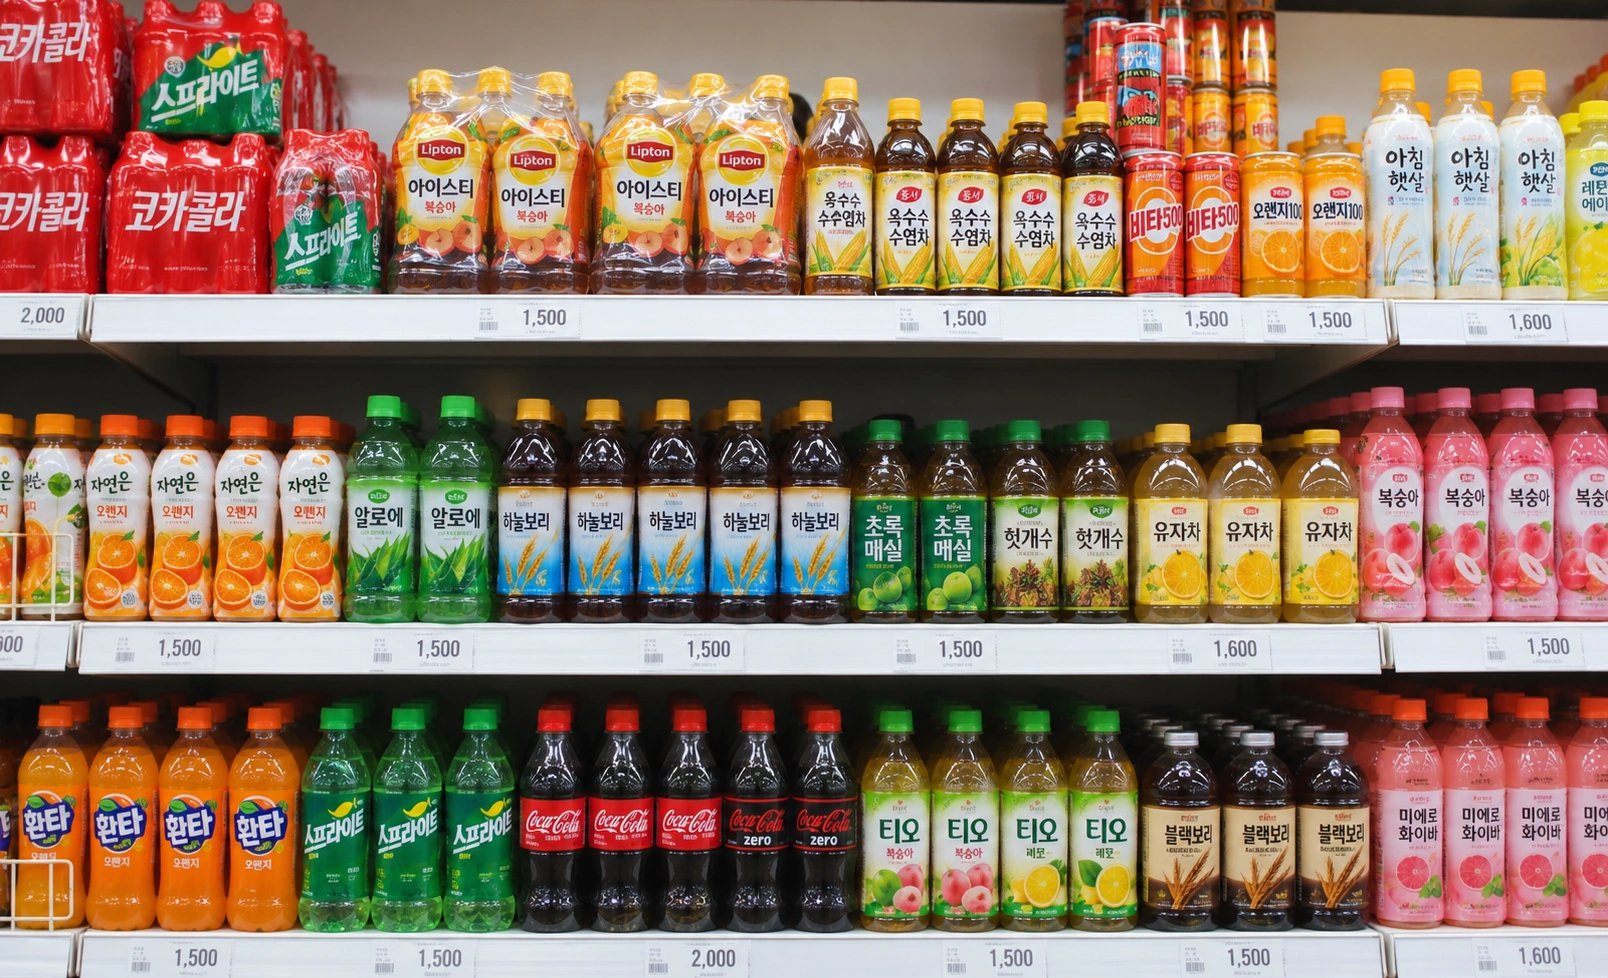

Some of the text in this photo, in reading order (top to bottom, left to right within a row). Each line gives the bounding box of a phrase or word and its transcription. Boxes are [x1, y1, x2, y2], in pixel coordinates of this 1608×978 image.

[0, 22, 91, 63] 코카콜라
[151, 59, 259, 123] 스프라이트
[422, 144, 461, 156] Lipton
[631, 146, 670, 158] Lipton
[1386, 147, 1423, 170] 아침
[1451, 147, 1489, 170] 아침
[514, 155, 552, 167] Lipton
[722, 154, 761, 167] Lipton
[1518, 149, 1555, 172] 아침
[409, 178, 474, 198] 아이스티
[617, 180, 682, 201] 아이스티
[1388, 171, 1424, 193] 햇살
[1454, 171, 1490, 193] 햇살
[1521, 172, 1556, 194] 햇살
[502, 188, 565, 207] 아이스티
[710, 188, 774, 208] 아이스티
[824, 191, 861, 208] 옥수수
[125, 191, 246, 232] 코카콜라
[888, 208, 929, 227] 옥수수
[949, 208, 991, 227] 옥수수
[1013, 210, 1054, 229] 옥수수
[1075, 212, 1116, 230] 옥수수
[1130, 205, 1183, 240] 비타500
[1187, 204, 1238, 240] 비타500
[284, 211, 361, 271] 스프라이트
[889, 228, 929, 246] 수염차
[951, 228, 992, 247] 수염차
[1014, 230, 1055, 248] 수염차
[1077, 232, 1116, 250] 수염차
[20, 307, 65, 325] 2,000
[523, 309, 566, 327] 1,500
[943, 310, 987, 328] 1,500
[1185, 310, 1228, 329] 1,500
[1308, 311, 1352, 329] 1,500
[1509, 314, 1551, 331] 1,600
[91, 471, 133, 494] 자연은
[157, 471, 199, 494] 자연은
[221, 471, 263, 494] 자연은
[288, 471, 331, 494] 자연은
[1378, 488, 1419, 507] 복숭아
[1445, 488, 1485, 507] 복숭아
[1509, 488, 1550, 507] 복숭아
[355, 507, 403, 528] 알로에
[432, 507, 480, 529] 알로에
[864, 515, 903, 538] 초록
[934, 515, 973, 538] 초록
[1004, 528, 1052, 549] 헛개수
[1153, 521, 1201, 542] 유자차
[1226, 521, 1274, 542] 유자차
[1305, 521, 1353, 542] 유자차
[864, 540, 902, 562] 매실
[934, 540, 972, 562] 매실
[158, 639, 201, 657] 1,500
[417, 640, 460, 658] 1,500
[687, 640, 730, 659] 1,500
[939, 640, 983, 659] 1,500
[1214, 640, 1257, 658] 1,600
[1528, 638, 1570, 656] 1,500
[24, 805, 71, 840] 환타
[1399, 808, 1438, 824] 미에로
[1462, 807, 1500, 824] 미에로
[1522, 806, 1561, 823] 미에로
[96, 807, 143, 844] 환타
[166, 809, 212, 845] 환타
[237, 811, 284, 847] 환타
[304, 807, 364, 854] 스프라이트
[378, 807, 438, 854] 스프라이트
[452, 807, 512, 854] 스프라이트
[879, 818, 920, 843] 티오
[948, 818, 989, 843] 티오
[1016, 818, 1058, 843] 티오
[1086, 818, 1127, 843] 티오
[1165, 824, 1212, 846] 블랙보리
[1243, 824, 1290, 846] 블랙보리
[1318, 823, 1365, 845] 블랙보리
[1399, 826, 1438, 842] 화이바
[1462, 825, 1500, 842] 화이바
[1522, 824, 1561, 841] 화이바
[744, 836, 771, 845] zero
[810, 836, 838, 846] zero
[175, 949, 217, 968] 1,500
[419, 949, 462, 968] 1,500
[692, 949, 735, 969] 2,000
[989, 949, 1032, 968] 1,500
[1228, 948, 1270, 968] 1,500
[1519, 946, 1561, 966] 1,600
